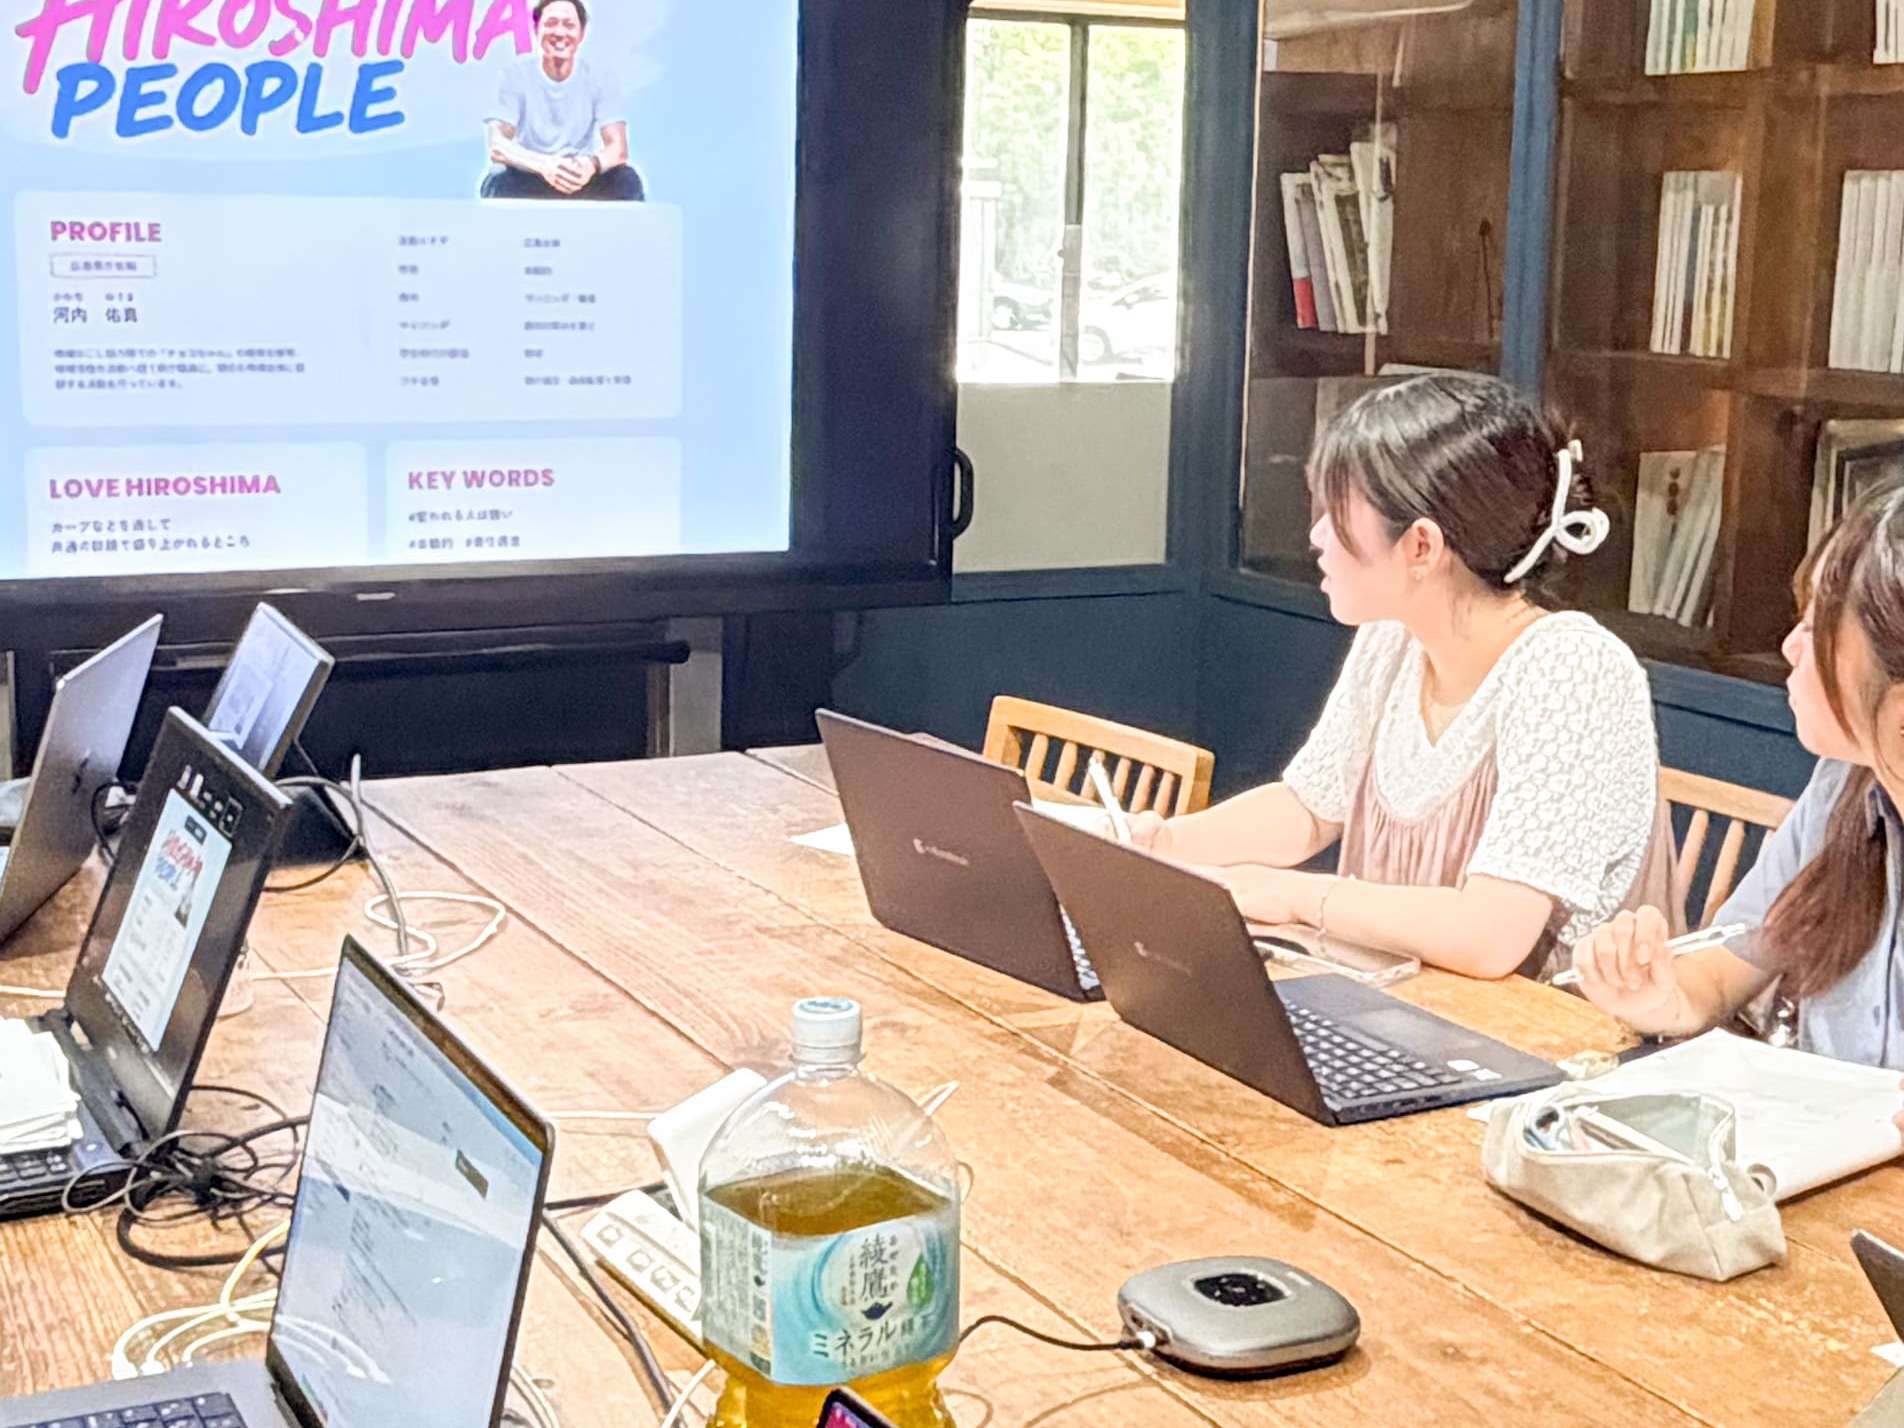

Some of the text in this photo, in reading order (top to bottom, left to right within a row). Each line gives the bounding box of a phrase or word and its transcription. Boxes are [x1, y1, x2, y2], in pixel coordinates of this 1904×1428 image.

[51, 60, 405, 138] PEOPLE
[50, 220, 162, 243] PROFILE
[49, 474, 281, 499] LOVE HIROSHIMA
[408, 468, 555, 490] KEY WORDS
